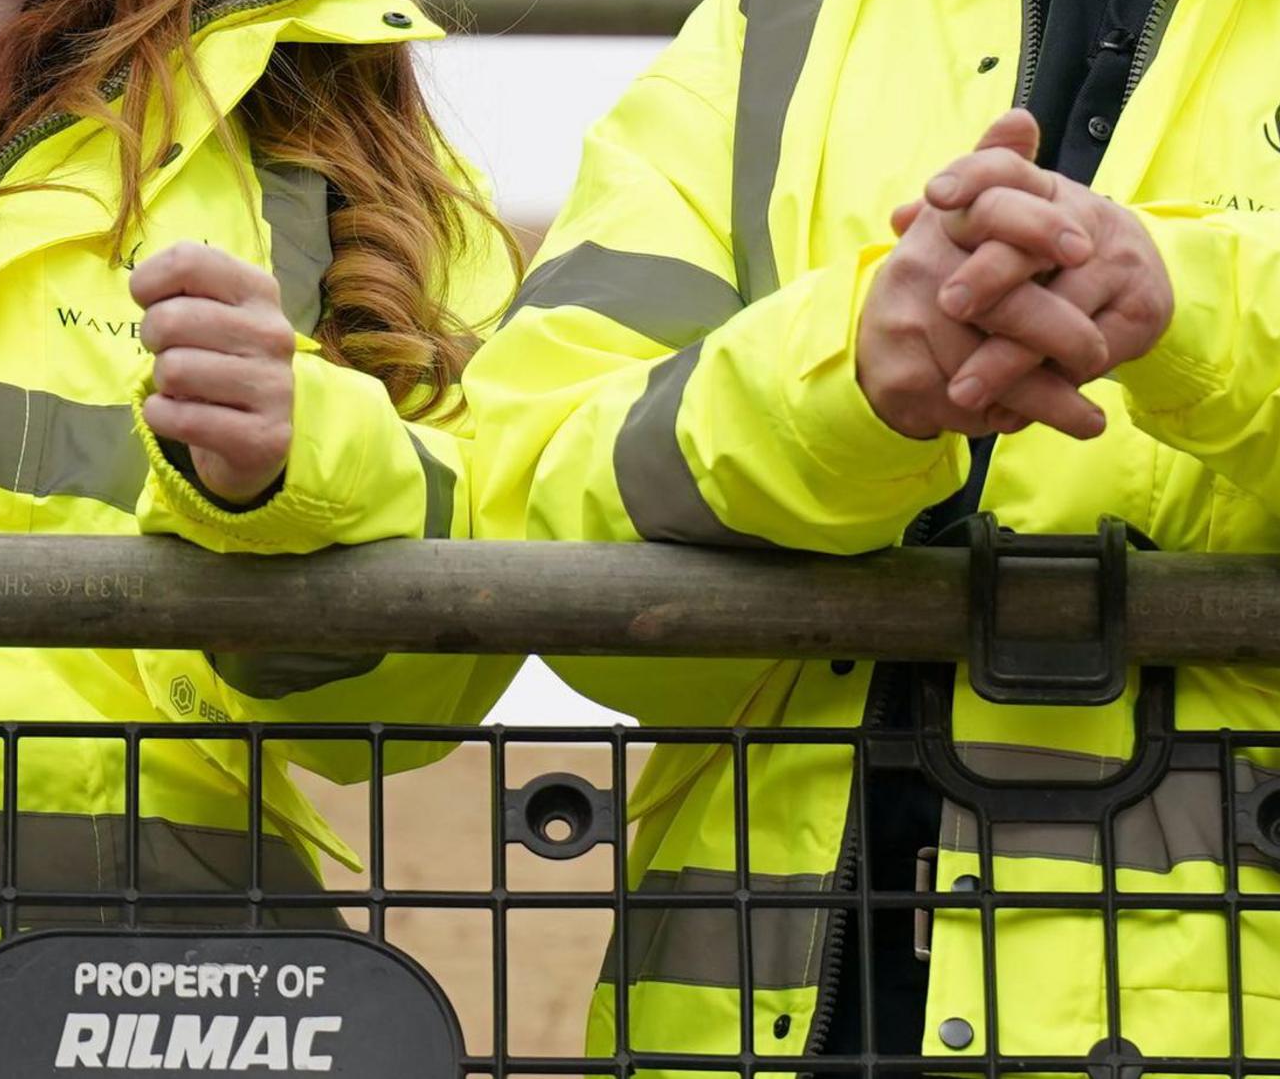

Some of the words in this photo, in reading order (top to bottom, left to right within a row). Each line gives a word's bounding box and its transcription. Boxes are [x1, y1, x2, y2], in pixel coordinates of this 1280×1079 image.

[56, 307, 142, 339] WAVE
[74, 961, 267, 998] PROPERTY
[276, 964, 326, 999] OF
[54, 1012, 343, 1072] RILMAC
